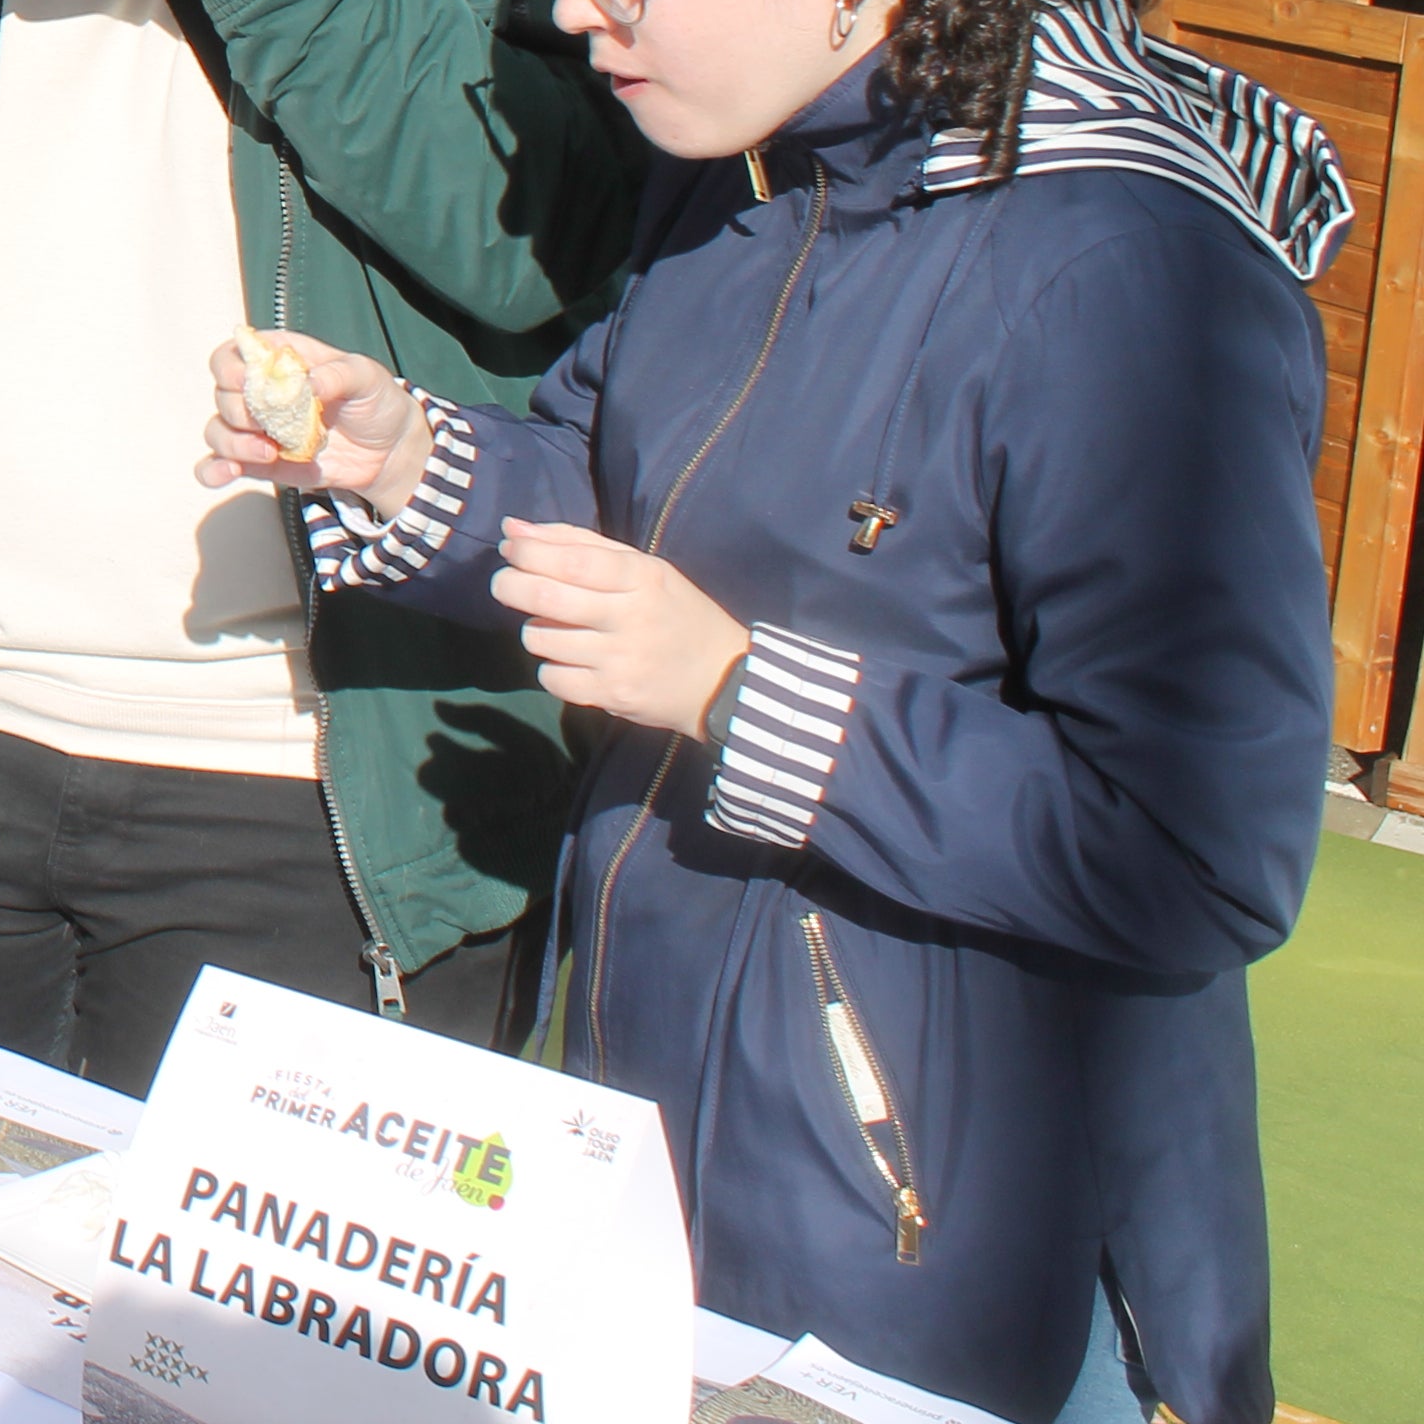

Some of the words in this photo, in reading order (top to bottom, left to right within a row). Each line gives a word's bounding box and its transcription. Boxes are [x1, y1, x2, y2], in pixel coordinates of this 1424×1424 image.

[274, 1069, 332, 1098] FIESTA
[250, 1084, 337, 1130] PRIMER
[338, 1101, 512, 1186] ACEITE
[589, 1127, 621, 1144] OLEO
[394, 1153, 425, 1179] de
[425, 1160, 486, 1206] Jaén
[179, 1167, 509, 1327] PANADERÍA
[108, 1218, 174, 1286] LA
[189, 1248, 547, 1424] LABRADORA
[815, 1376, 858, 1402] VER
